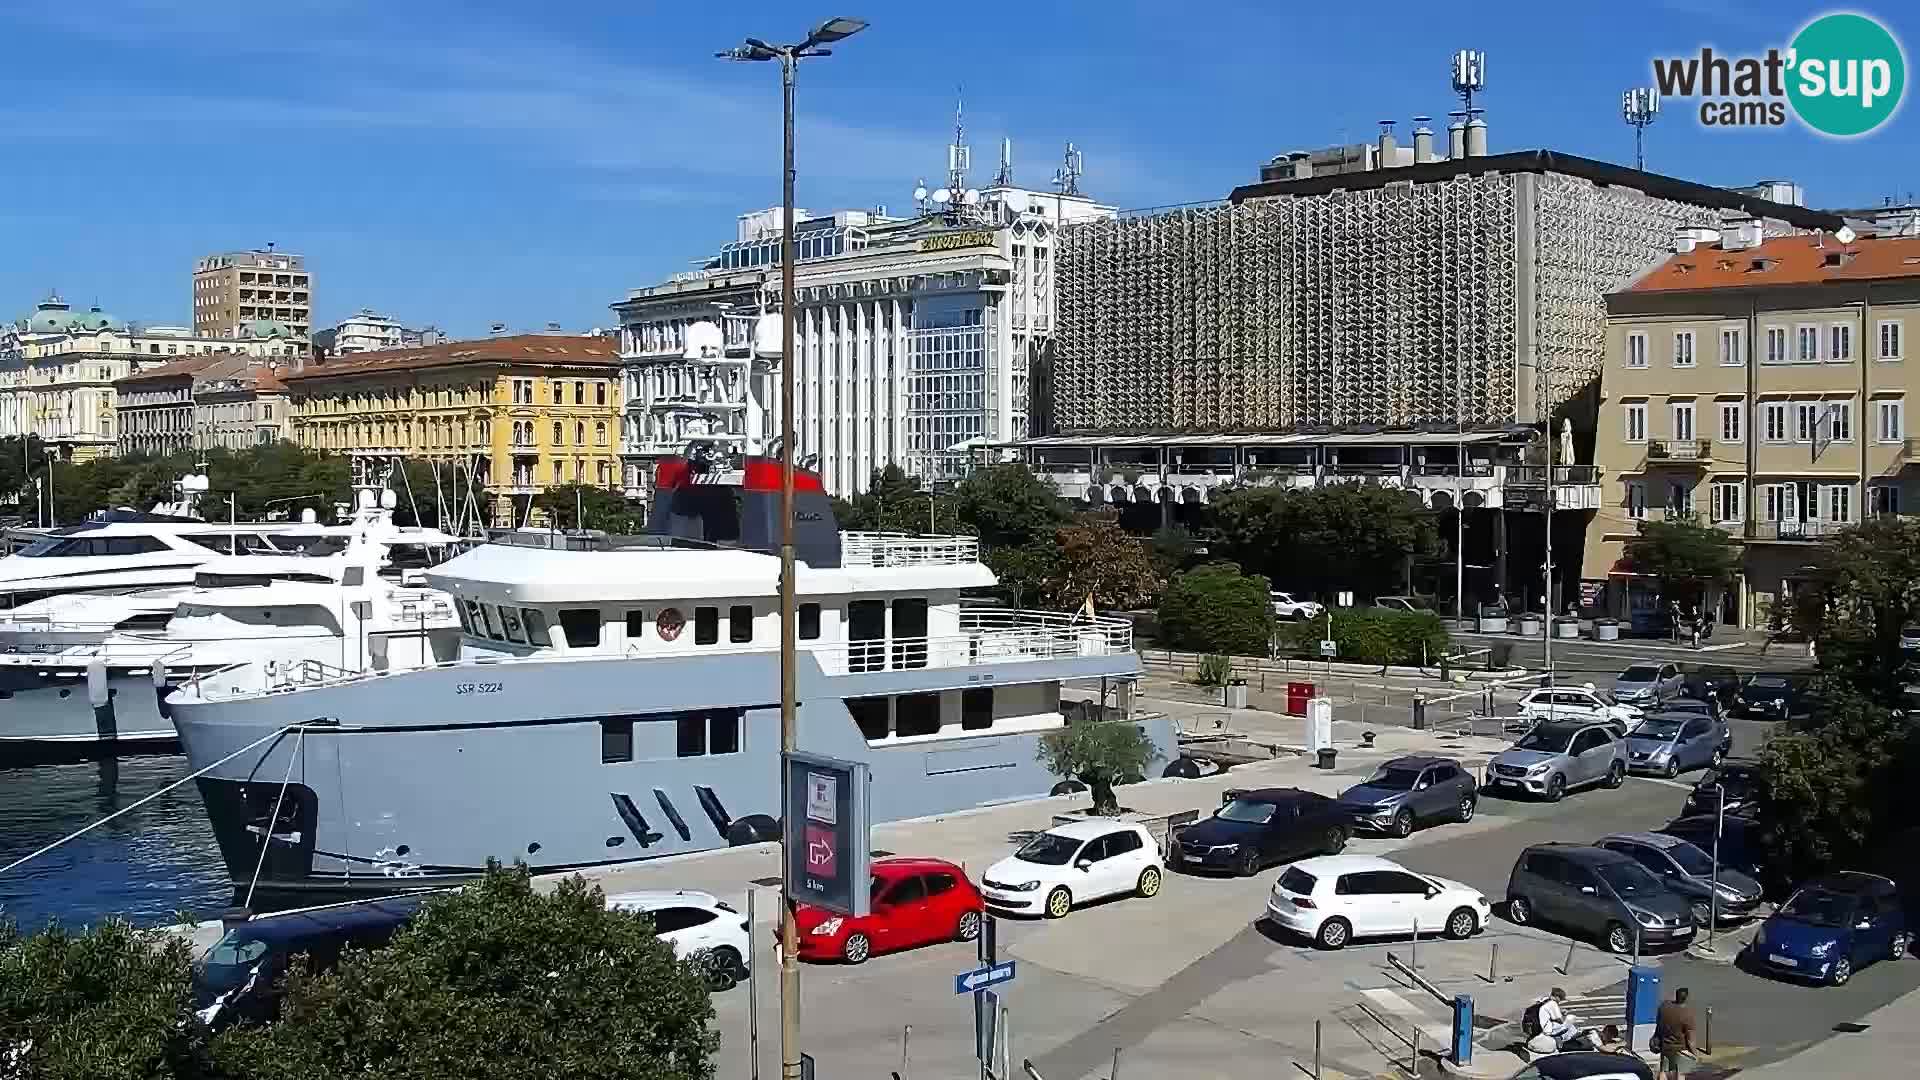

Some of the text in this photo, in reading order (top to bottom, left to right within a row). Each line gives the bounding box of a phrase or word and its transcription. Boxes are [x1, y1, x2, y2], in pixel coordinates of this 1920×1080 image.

[456, 682, 503, 694] SSR 5224
[812, 879, 824, 892] km
